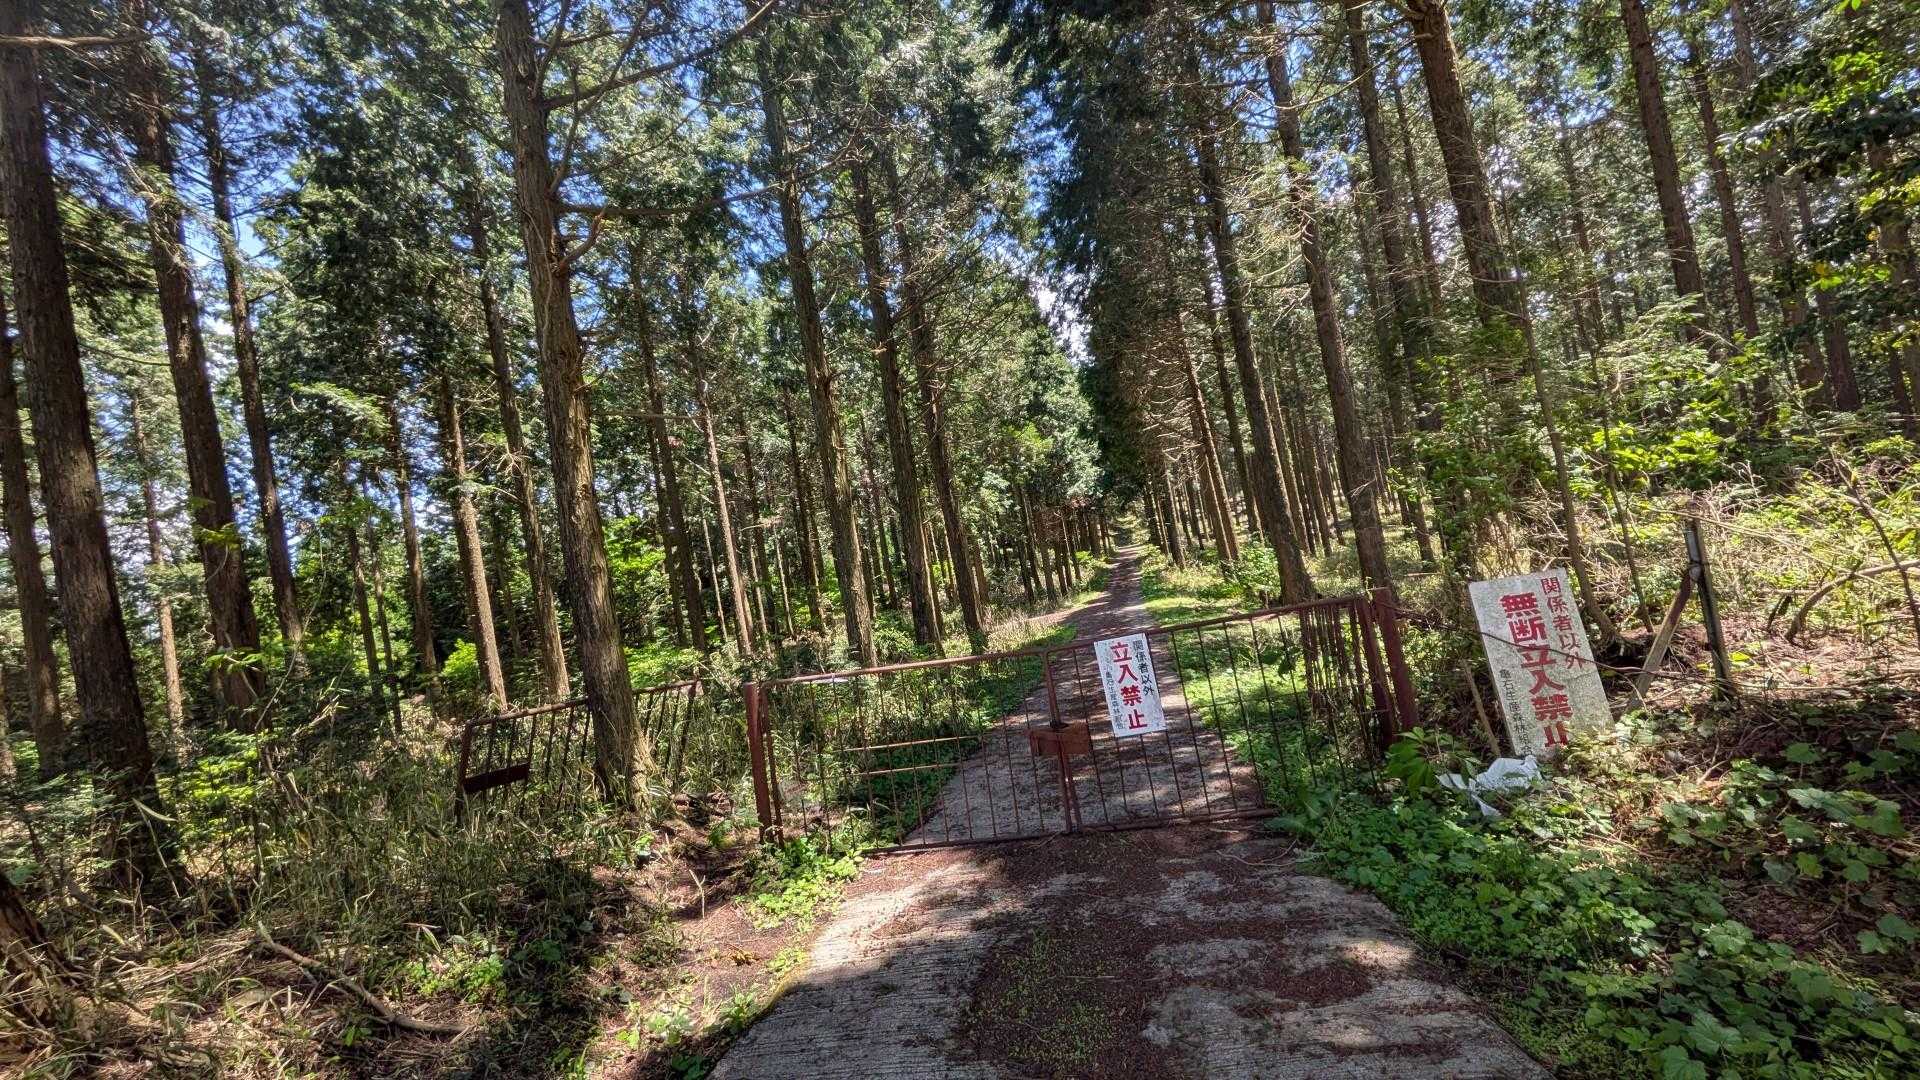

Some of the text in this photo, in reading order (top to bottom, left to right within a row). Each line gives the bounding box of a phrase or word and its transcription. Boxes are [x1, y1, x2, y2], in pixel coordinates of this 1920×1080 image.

[1132, 639, 1155, 696] 関係者以外
[1540, 576, 1586, 670] 関係者以外
[1110, 641, 1148, 730] 立入禁止
[1499, 592, 1573, 748] 無断立入禁止
